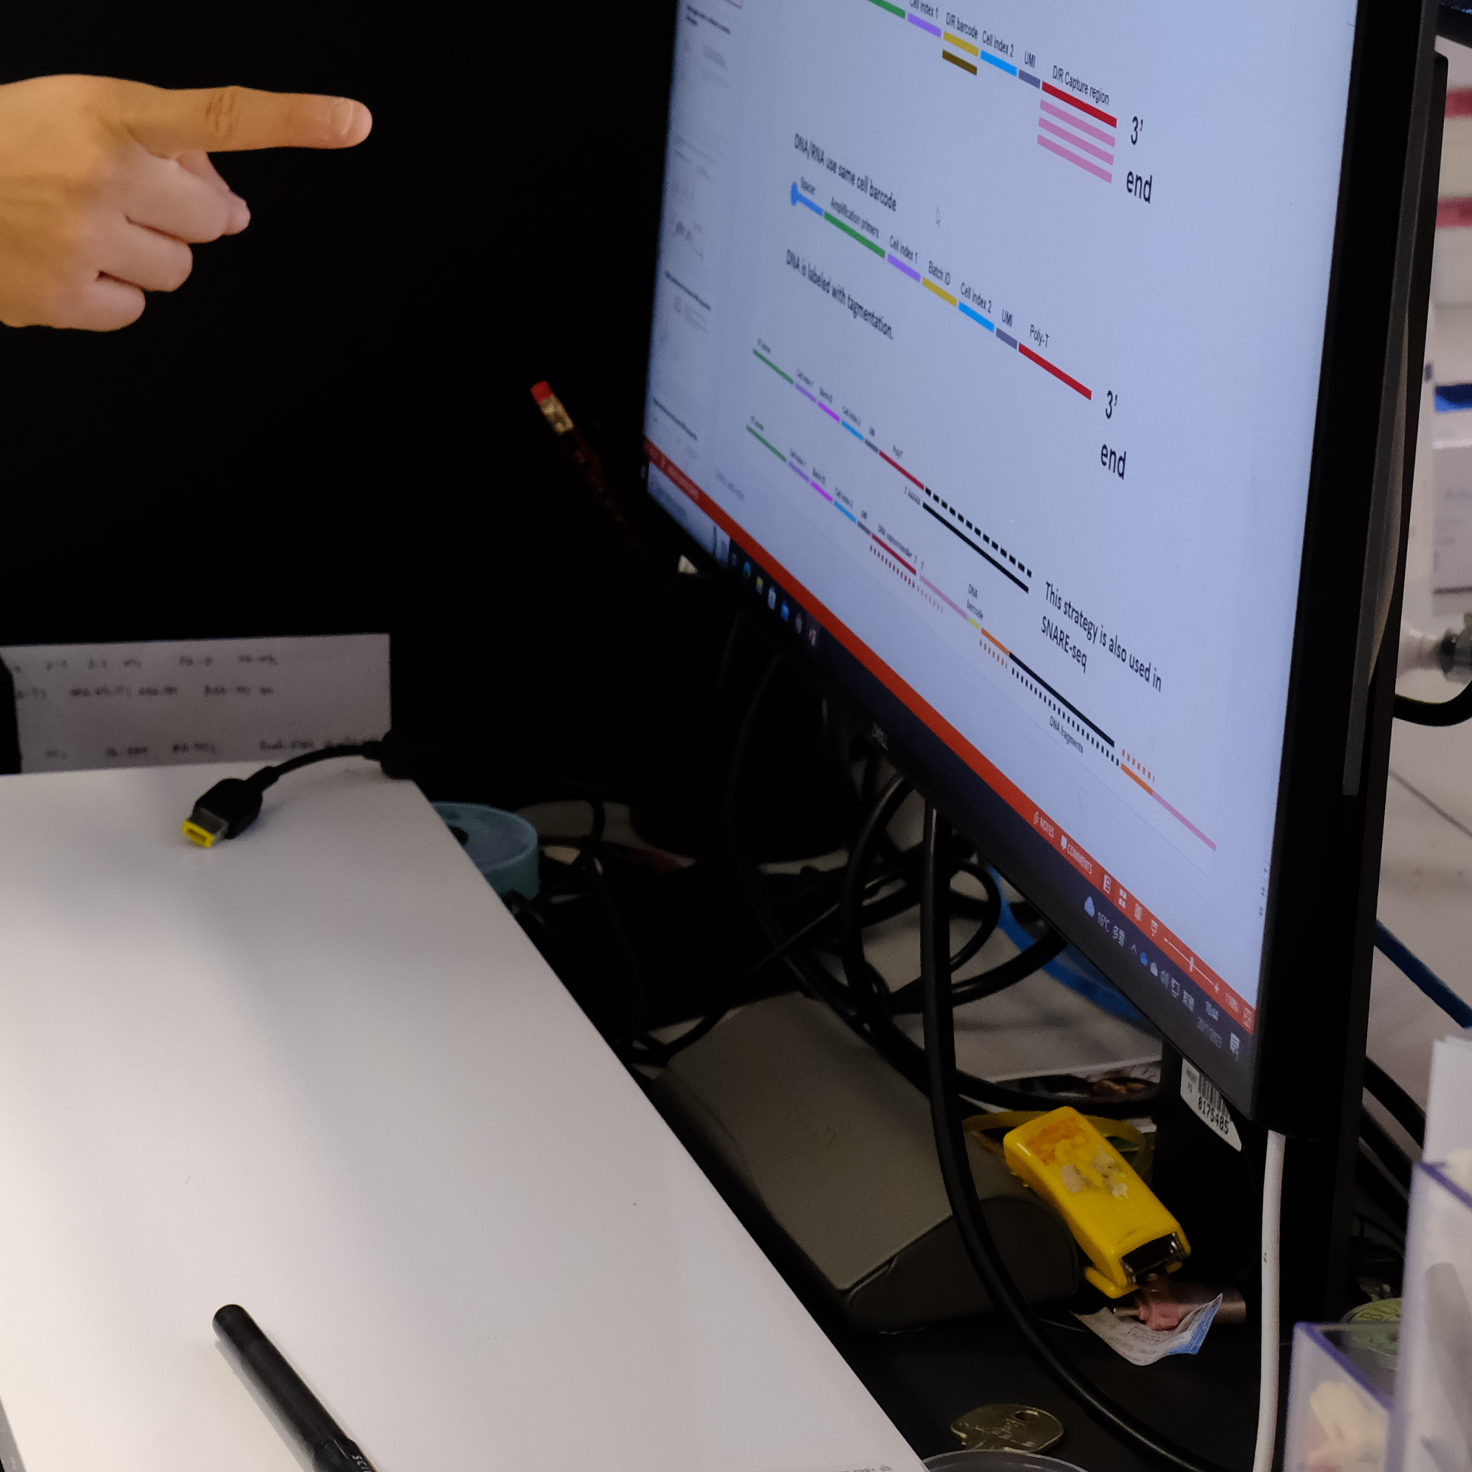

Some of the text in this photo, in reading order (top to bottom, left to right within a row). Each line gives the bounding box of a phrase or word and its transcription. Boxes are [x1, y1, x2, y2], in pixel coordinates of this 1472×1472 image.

[956, 16, 979, 40] barcode
[981, 30, 993, 47] Cell
[1024, 50, 1037, 69] UMI
[1064, 71, 1089, 95] Capture
[1089, 86, 1110, 106] region
[794, 132, 897, 212] DNA/RNA use same cell barcode
[1125, 170, 1153, 204] end
[928, 260, 945, 282] Batch
[785, 248, 800, 273] DNA
[807, 261, 832, 294] labeled
[831, 283, 847, 306] with
[847, 293, 894, 341] tagmentation.
[960, 281, 971, 300] Cell
[1001, 308, 1014, 328] UMI
[1029, 324, 1050, 348] Poly-T
[1100, 443, 1127, 480] end
[1040, 614, 1088, 675] SNARE-seq
[1045, 580, 1162, 693] This strategy is also used in
[1039, 816, 1055, 839] NOTES
[1066, 842, 1093, 875] COMMENTS
